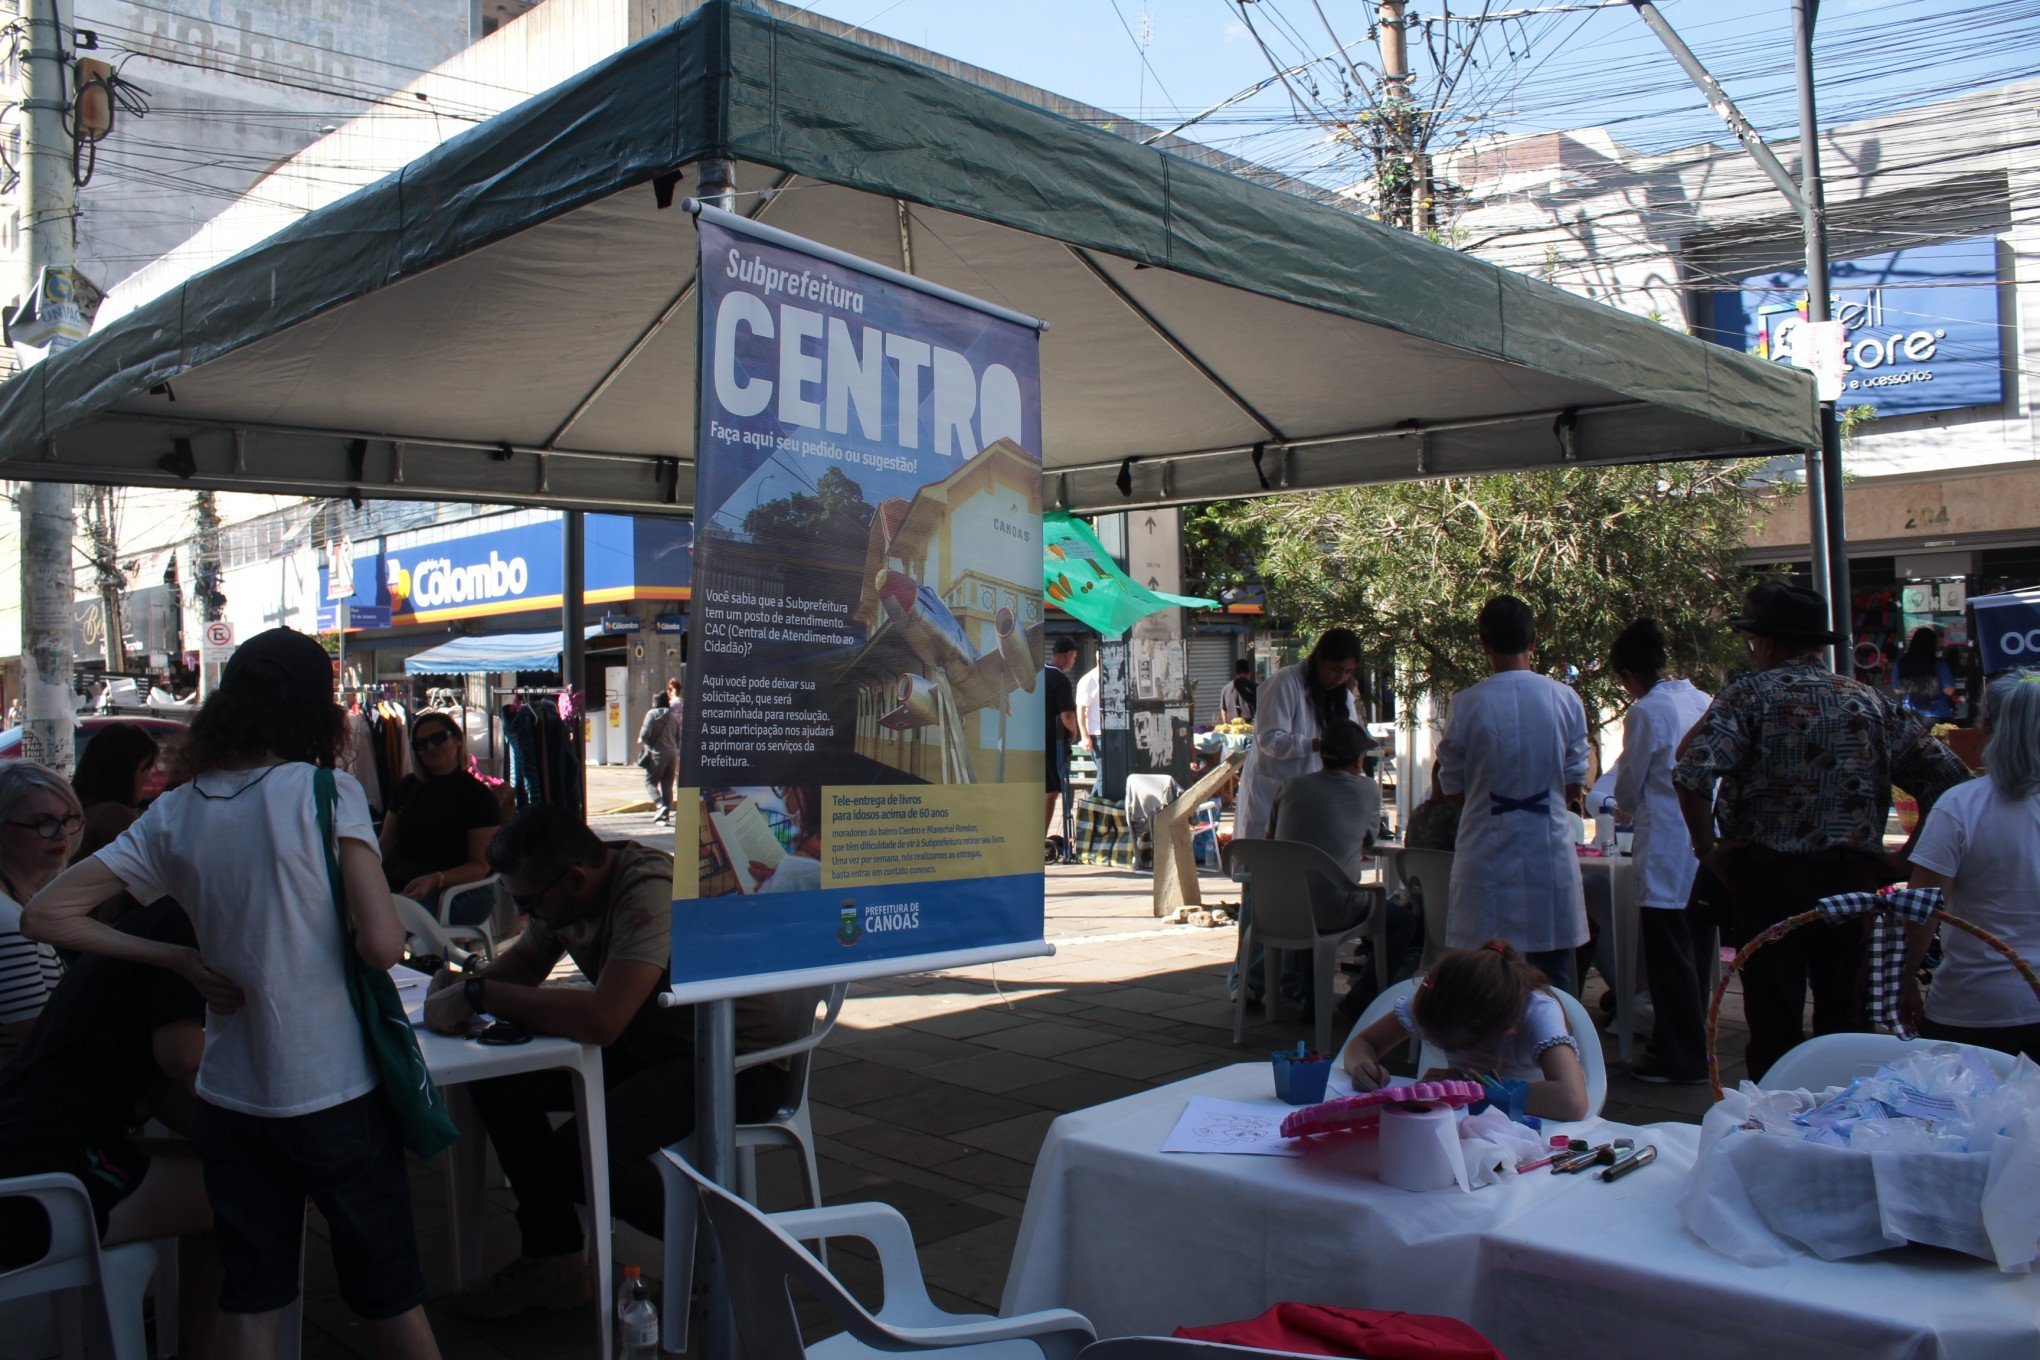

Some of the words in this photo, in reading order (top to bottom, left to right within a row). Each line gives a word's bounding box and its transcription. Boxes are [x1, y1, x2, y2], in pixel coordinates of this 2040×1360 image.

[727, 249, 864, 314] Subprefeitura
[714, 291, 1021, 460] CENTRO
[1862, 369, 1933, 387] acessórios
[710, 421, 740, 444] Faça
[743, 428, 774, 449] aqui
[776, 437, 800, 452] seu
[802, 437, 843, 461] pedido
[845, 448, 861, 463] ou
[863, 450, 917, 473] sugestão!
[1905, 505, 1949, 529] 204
[993, 518, 1030, 542] CANOAS
[706, 589, 729, 602] Você
[731, 593, 756, 605] sabia
[758, 597, 776, 608] que
[778, 598, 784, 608] a
[785, 596, 848, 613] Subprefeitura
[705, 607, 724, 619] tem
[726, 611, 742, 620] um
[744, 612, 770, 624] posto
[772, 612, 784, 624] de
[785, 614, 843, 629] atendimento
[705, 623, 726, 636] CAC
[728, 623, 767, 639] (Central
[768, 628, 780, 640] de
[782, 628, 842, 645] Atendimento
[843, 636, 854, 645] ao
[704, 639, 752, 657] Cidadão)?
[702, 674, 724, 688] Aqui
[725, 675, 747, 688] você
[749, 676, 770, 690] pode
[772, 677, 799, 689] deixar
[800, 680, 816, 690] sua
[702, 690, 754, 706] solicitação,
[755, 695, 771, 706] que
[773, 693, 792, 705] será
[701, 707, 763, 720] encaminhada
[764, 710, 784, 722] para
[786, 709, 830, 723] resolução.
[701, 723, 709, 734] A
[710, 725, 727, 735] sua
[728, 724, 784, 738] participação
[785, 726, 800, 736] nos
[801, 725, 835, 738] ajudará
[701, 741, 707, 750] a
[708, 740, 754, 753] aprimorar
[755, 741, 766, 751] os
[767, 740, 802, 754] serviços
[803, 740, 815, 751] da
[701, 755, 750, 767] Prefeitura.
[832, 794, 886, 808] Tele-entrega
[887, 794, 898, 805] de
[899, 794, 922, 805] livros
[832, 810, 852, 823] para
[853, 809, 880, 821] idosos
[881, 807, 906, 820] acima
[907, 807, 918, 819] de
[919, 807, 930, 819] 60
[931, 808, 949, 818] anos
[832, 826, 868, 838] moradores
[869, 825, 877, 836] do
[878, 825, 898, 835] bairro
[899, 825, 920, 835] Centro
[927, 824, 955, 834] Marechal
[832, 843, 845, 853] que
[845, 841, 859, 851] têm
[860, 839, 896, 850] dificuldade
[897, 839, 906, 849] de
[907, 839, 916, 848] vir
[921, 836, 962, 848] Subprefeitura
[963, 836, 980, 845] retirar
[981, 836, 992, 844] seu
[832, 856, 848, 866] Uma
[848, 857, 860, 865] vez
[861, 857, 872, 866] por
[873, 855, 899, 864] semana,
[901, 852, 913, 861] nós
[914, 851, 948, 861] realizamos
[832, 869, 850, 880] basta
[851, 869, 871, 878] entrar
[872, 869, 882, 877] em
[883, 867, 909, 876] contato
[909, 866, 937, 874] conosco.
[865, 904, 909, 916] PREFEITURA
[910, 902, 920, 912] DE
[865, 912, 920, 933] CANOAS
